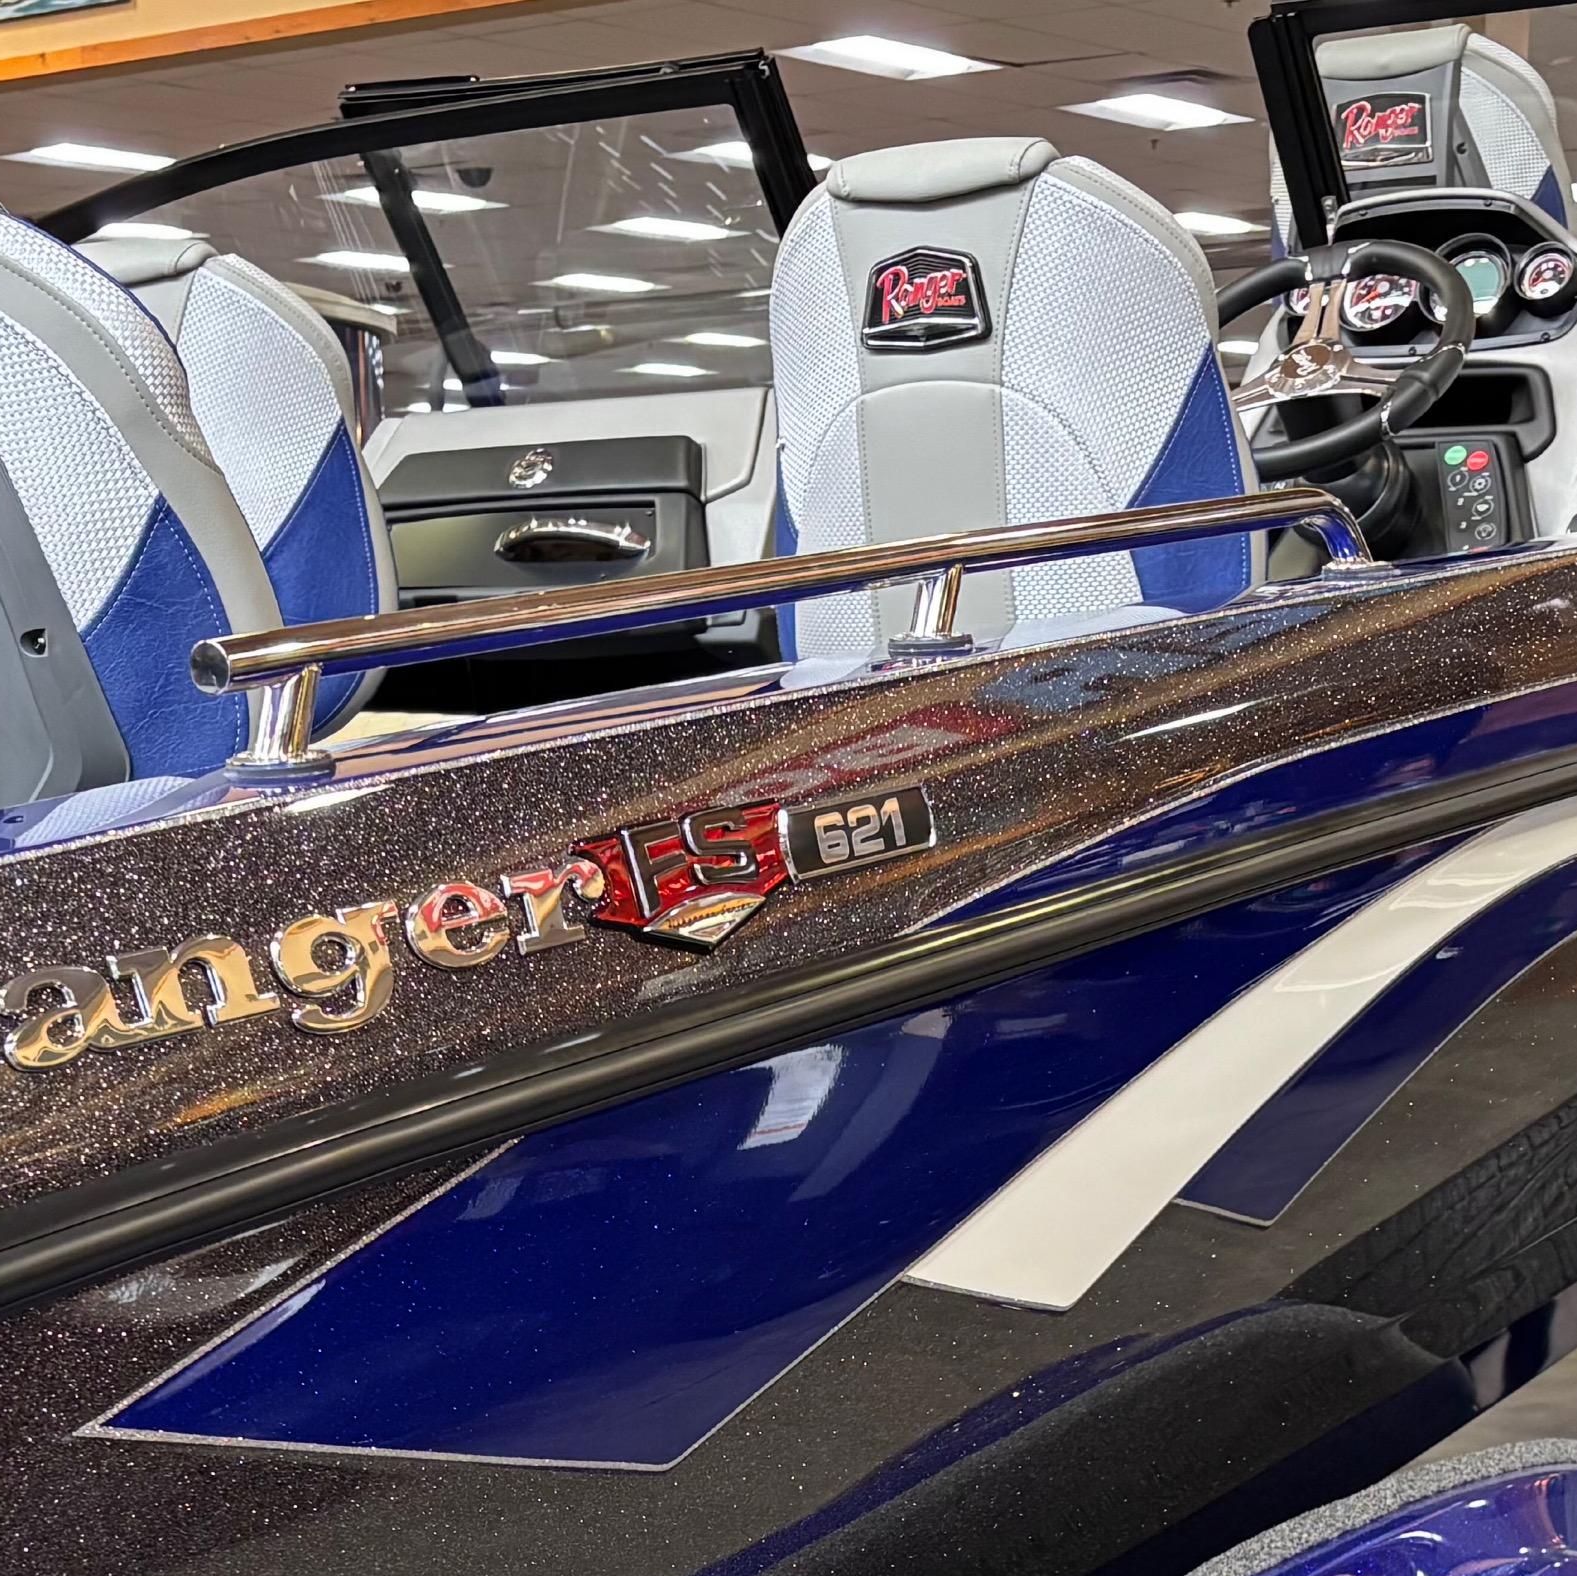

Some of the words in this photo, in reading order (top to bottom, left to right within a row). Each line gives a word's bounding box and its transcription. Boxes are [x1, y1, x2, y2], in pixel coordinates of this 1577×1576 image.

[876, 265, 964, 325] Ranger
[621, 806, 760, 917] FS
[813, 797, 907, 865] 621
